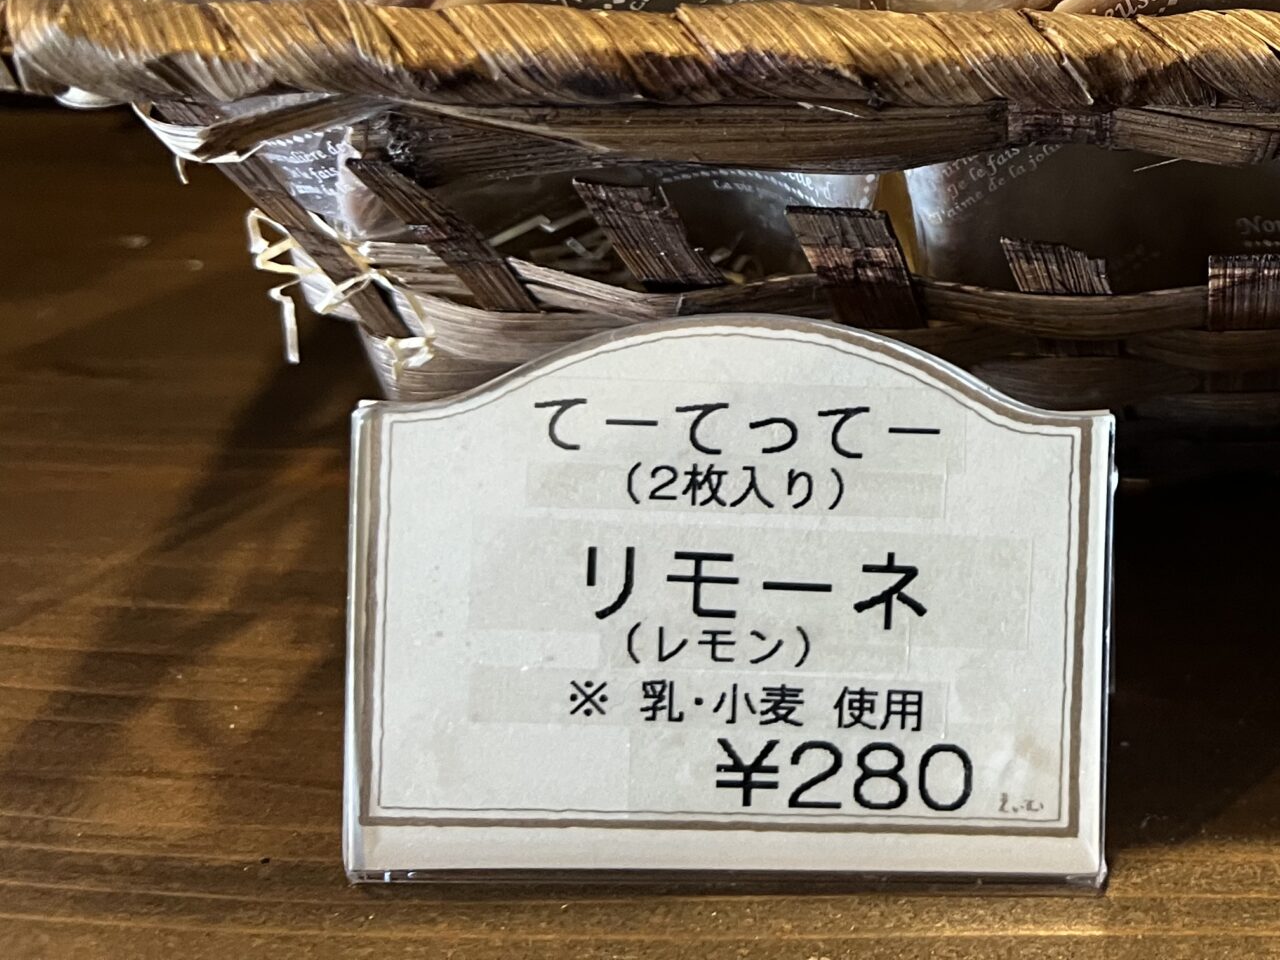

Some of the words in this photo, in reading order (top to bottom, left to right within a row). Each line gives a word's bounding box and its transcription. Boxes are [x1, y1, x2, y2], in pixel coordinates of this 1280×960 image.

[969, 166, 986, 181] le
[986, 147, 1021, 176] fais
[1009, 164, 1026, 178] la
[535, 398, 941, 459] てーてってー
[586, 546, 927, 630] リモーネ
[627, 622, 811, 668] (レモン)
[640, 680, 805, 727] 乳・小麦
[833, 686, 923, 732] 使用
[715, 738, 973, 812] ¥280
